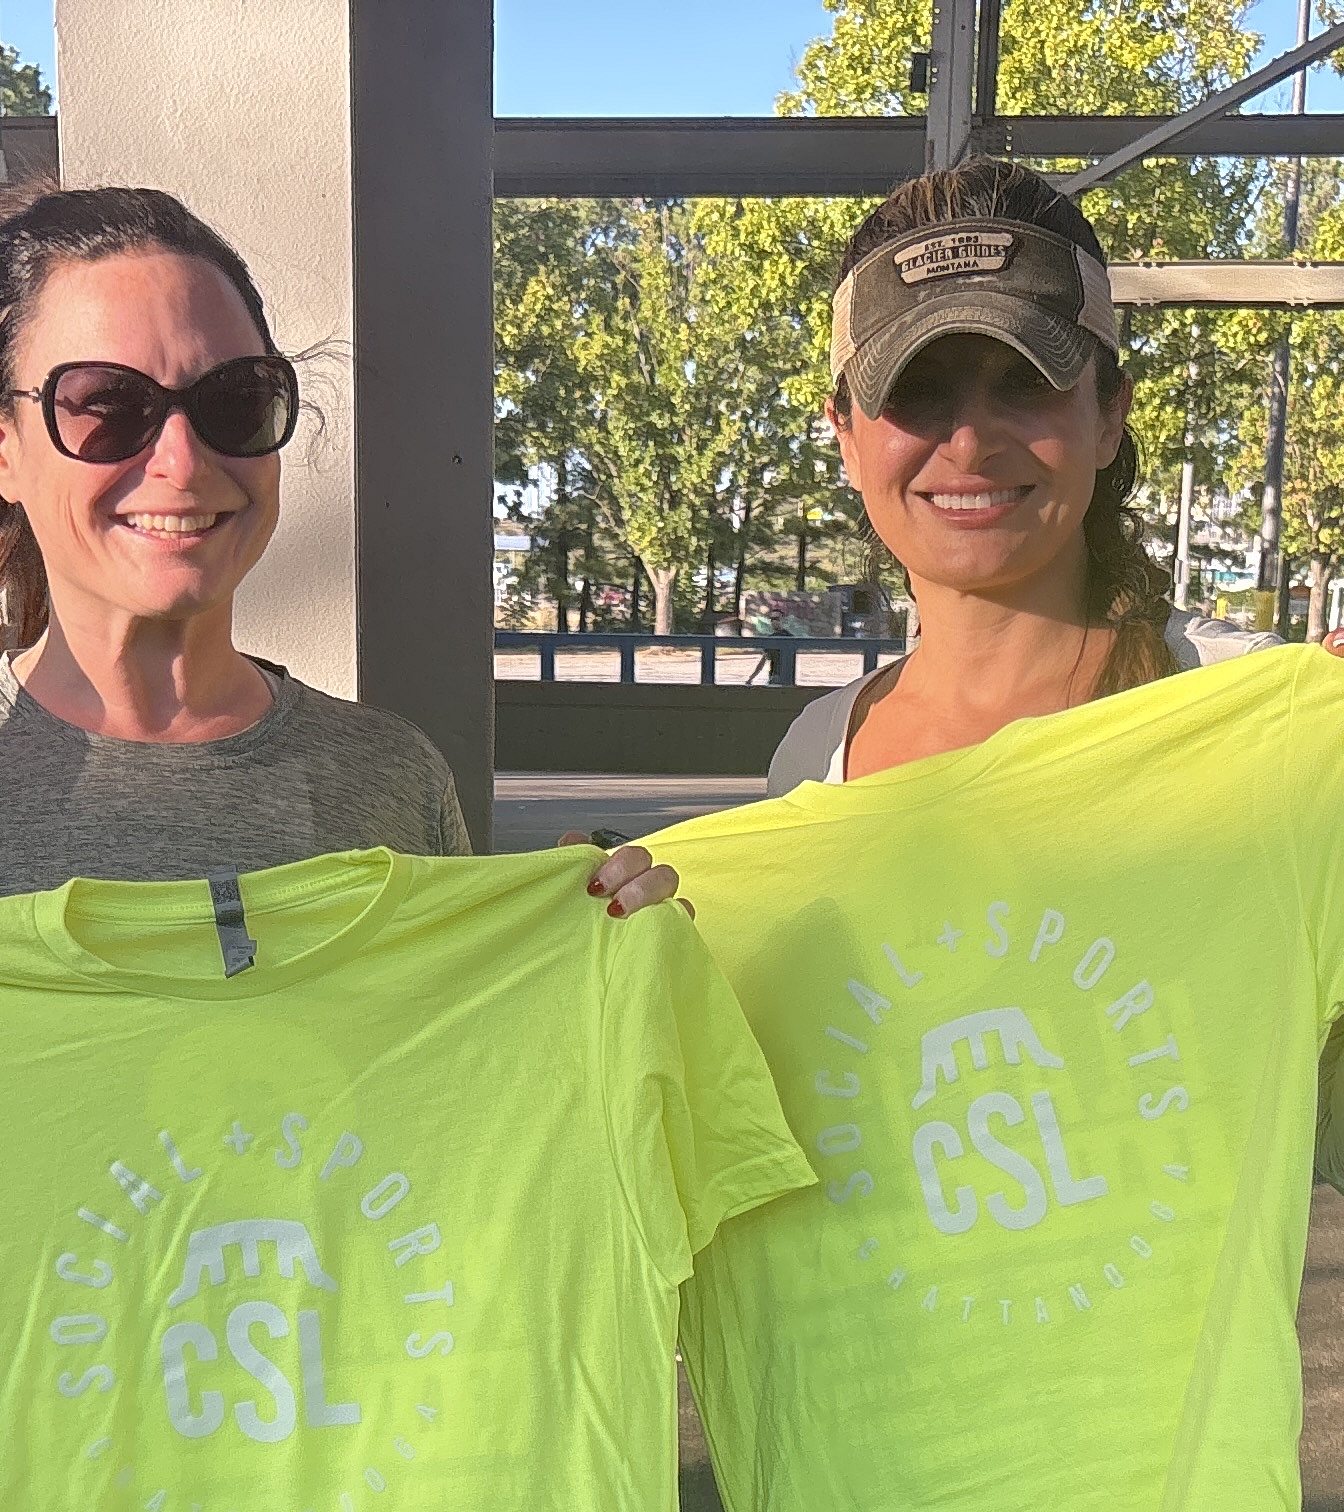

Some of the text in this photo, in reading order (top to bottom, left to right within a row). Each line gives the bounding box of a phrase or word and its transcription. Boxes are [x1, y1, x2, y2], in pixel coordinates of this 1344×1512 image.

[902, 245, 1006, 272] GLACIER GUIDES
[926, 260, 979, 275] MONTANA
[814, 942, 925, 1205] SOCIAL
[984, 901, 1189, 1121] SPORTS
[911, 1090, 1109, 1235] CSL
[49, 1130, 202, 1398] SOCIAL
[274, 1111, 454, 1359] SPORTS
[857, 1163, 1190, 1325] CHATTANOOGA
[162, 1300, 361, 1442] CSL
